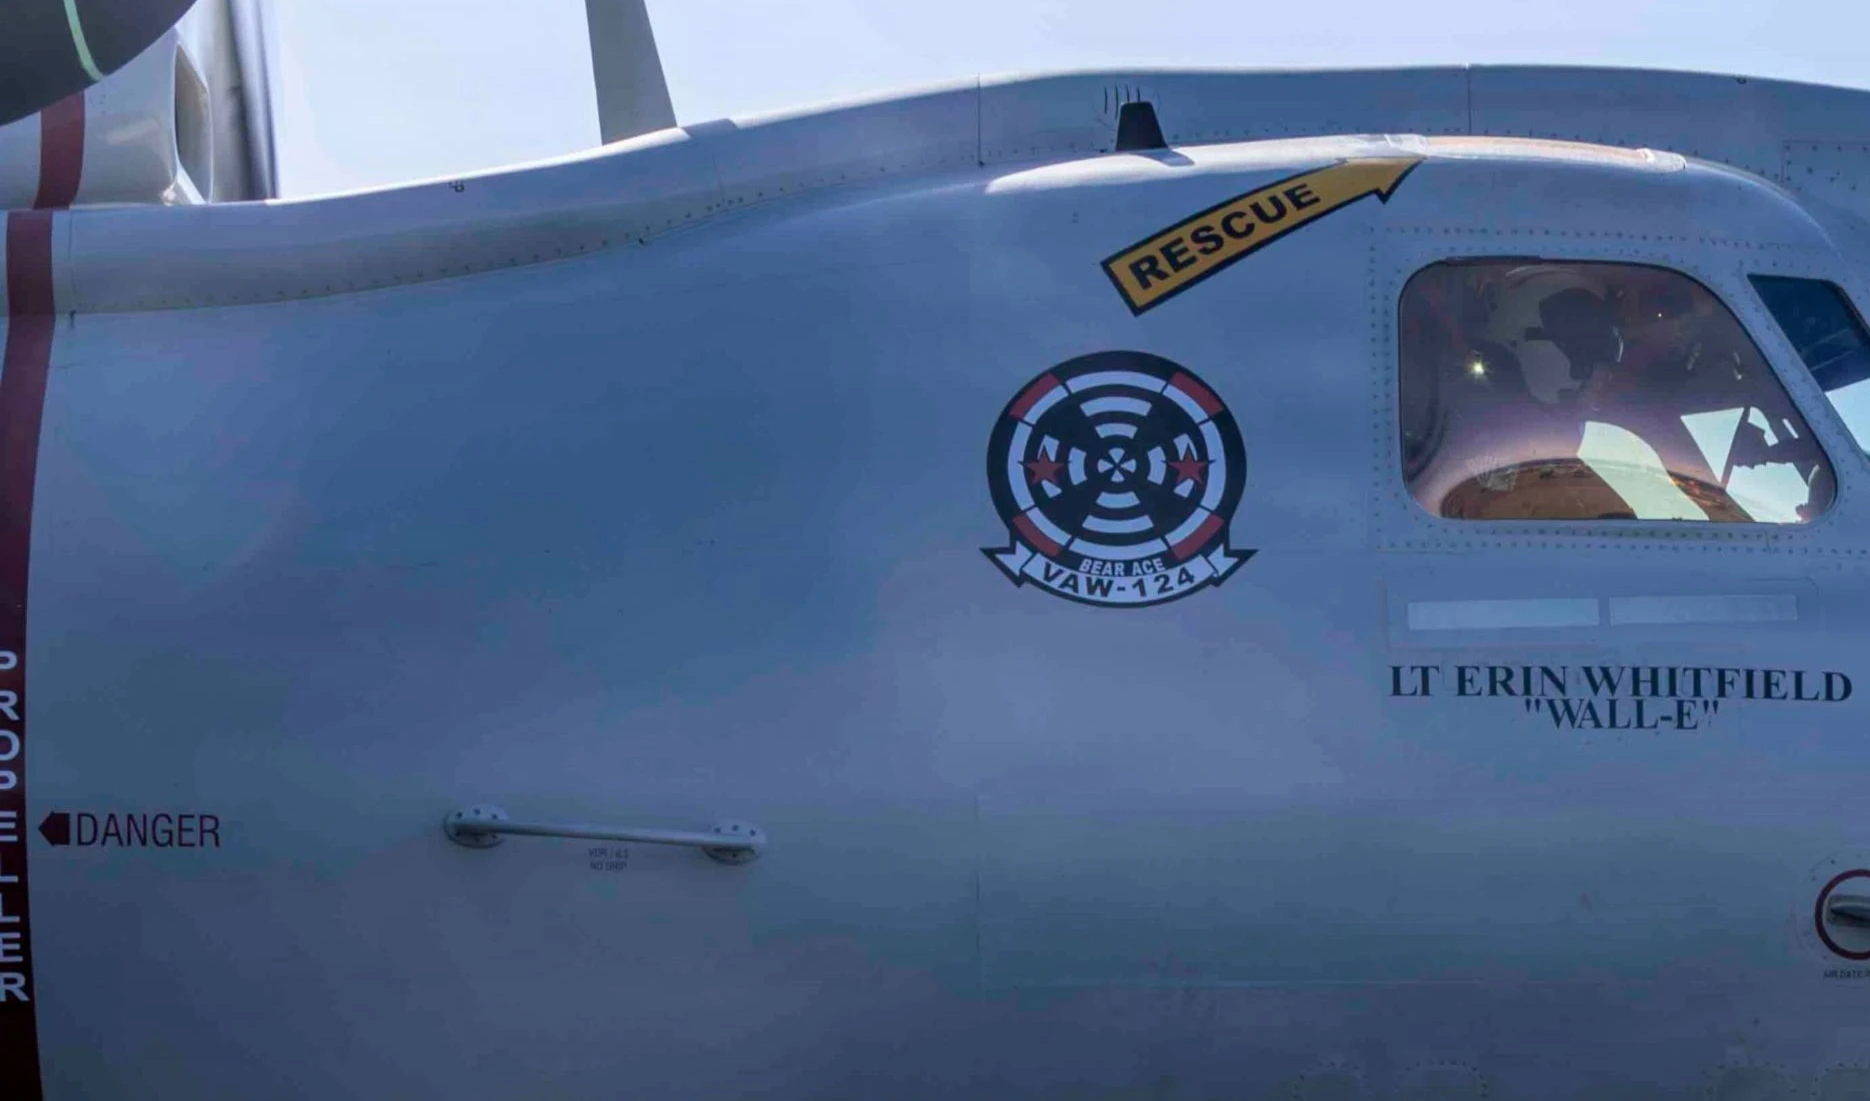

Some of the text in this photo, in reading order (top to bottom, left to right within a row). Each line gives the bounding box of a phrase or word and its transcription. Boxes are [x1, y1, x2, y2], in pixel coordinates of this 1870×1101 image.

[1127, 182, 1321, 291] RESCUE
[1043, 561, 1195, 598] VAW-124
[1078, 557, 1166, 577] BEAR ACE
[1388, 665, 1854, 702] LT ERIN WHITFIELD
[1524, 699, 1720, 731] "WALL-E"
[76, 812, 221, 848] DANGER
